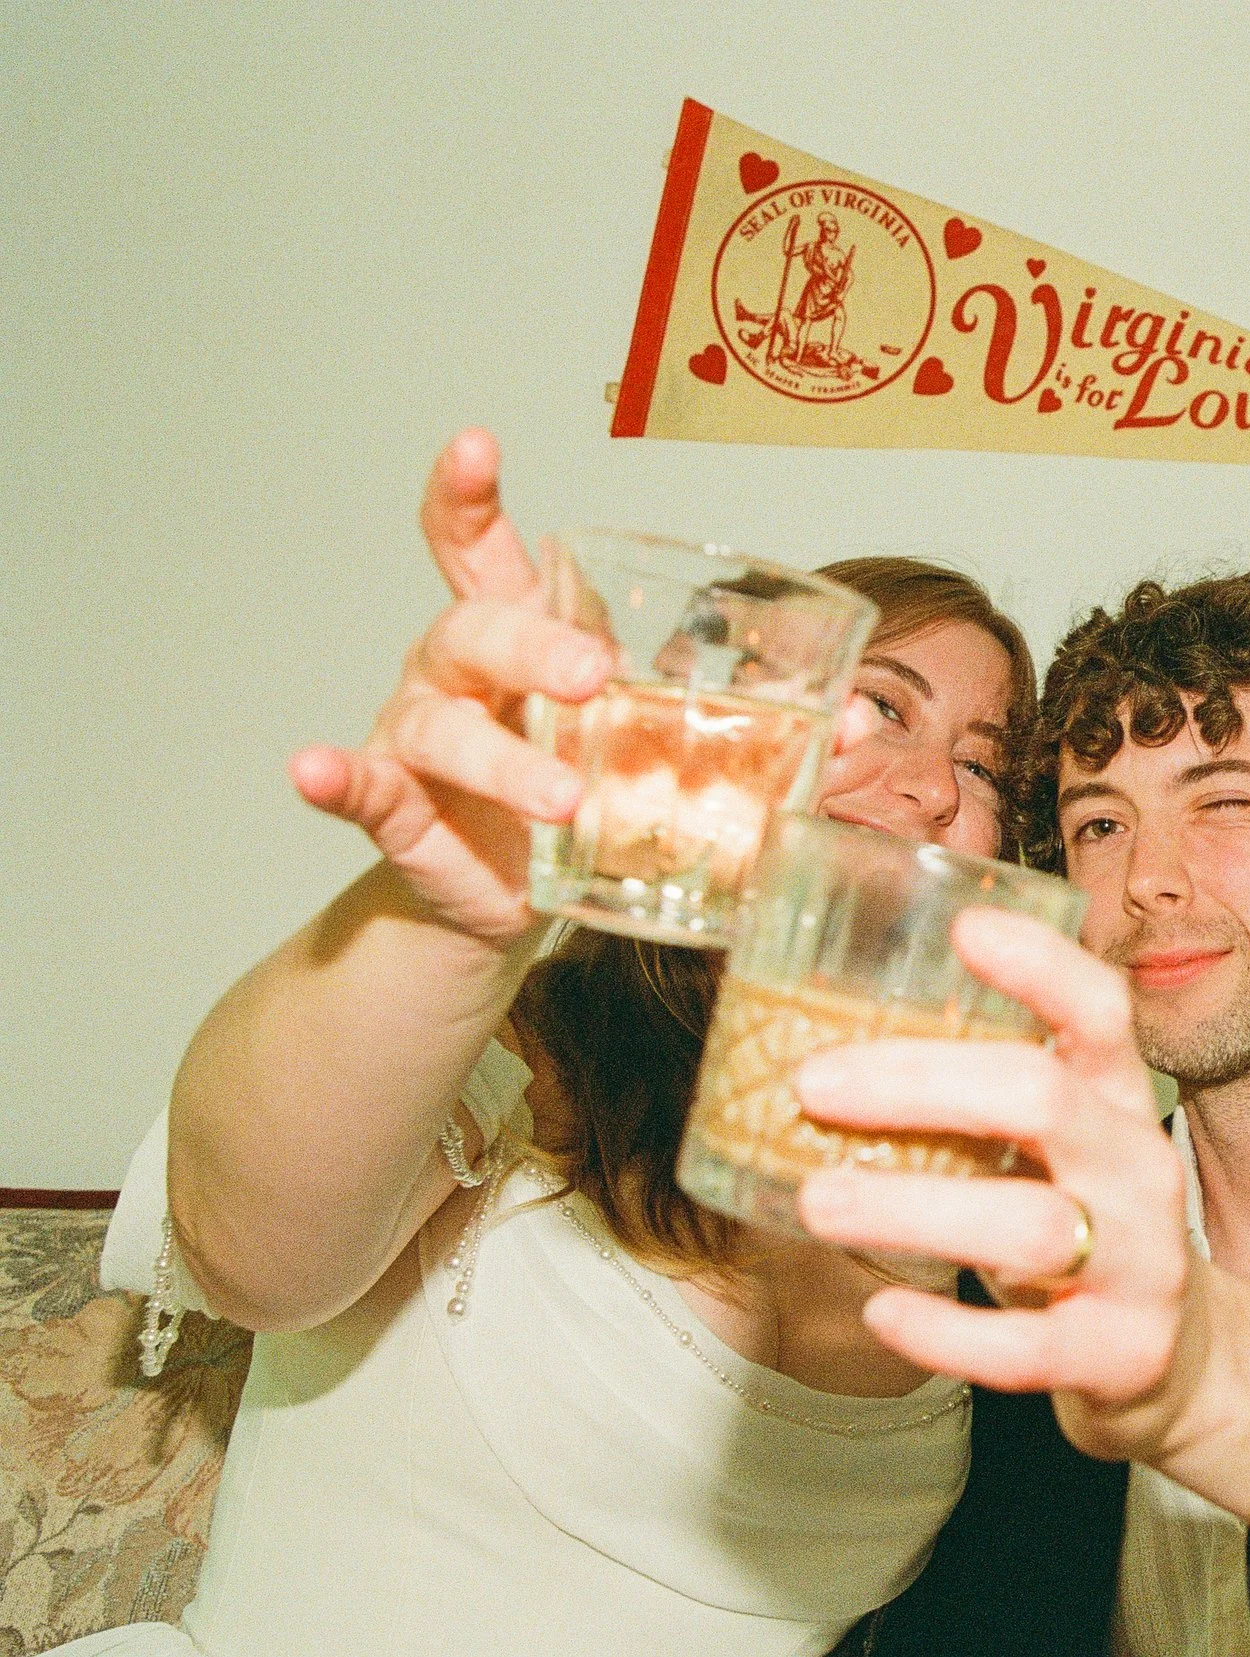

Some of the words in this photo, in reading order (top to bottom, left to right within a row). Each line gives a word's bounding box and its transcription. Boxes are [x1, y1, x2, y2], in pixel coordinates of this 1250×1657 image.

[740, 201, 787, 241] SEAL
[789, 189, 814, 208] OF
[821, 188, 911, 248] VIRGINIA
[1055, 362, 1071, 390] is
[1076, 376, 1123, 411] for
